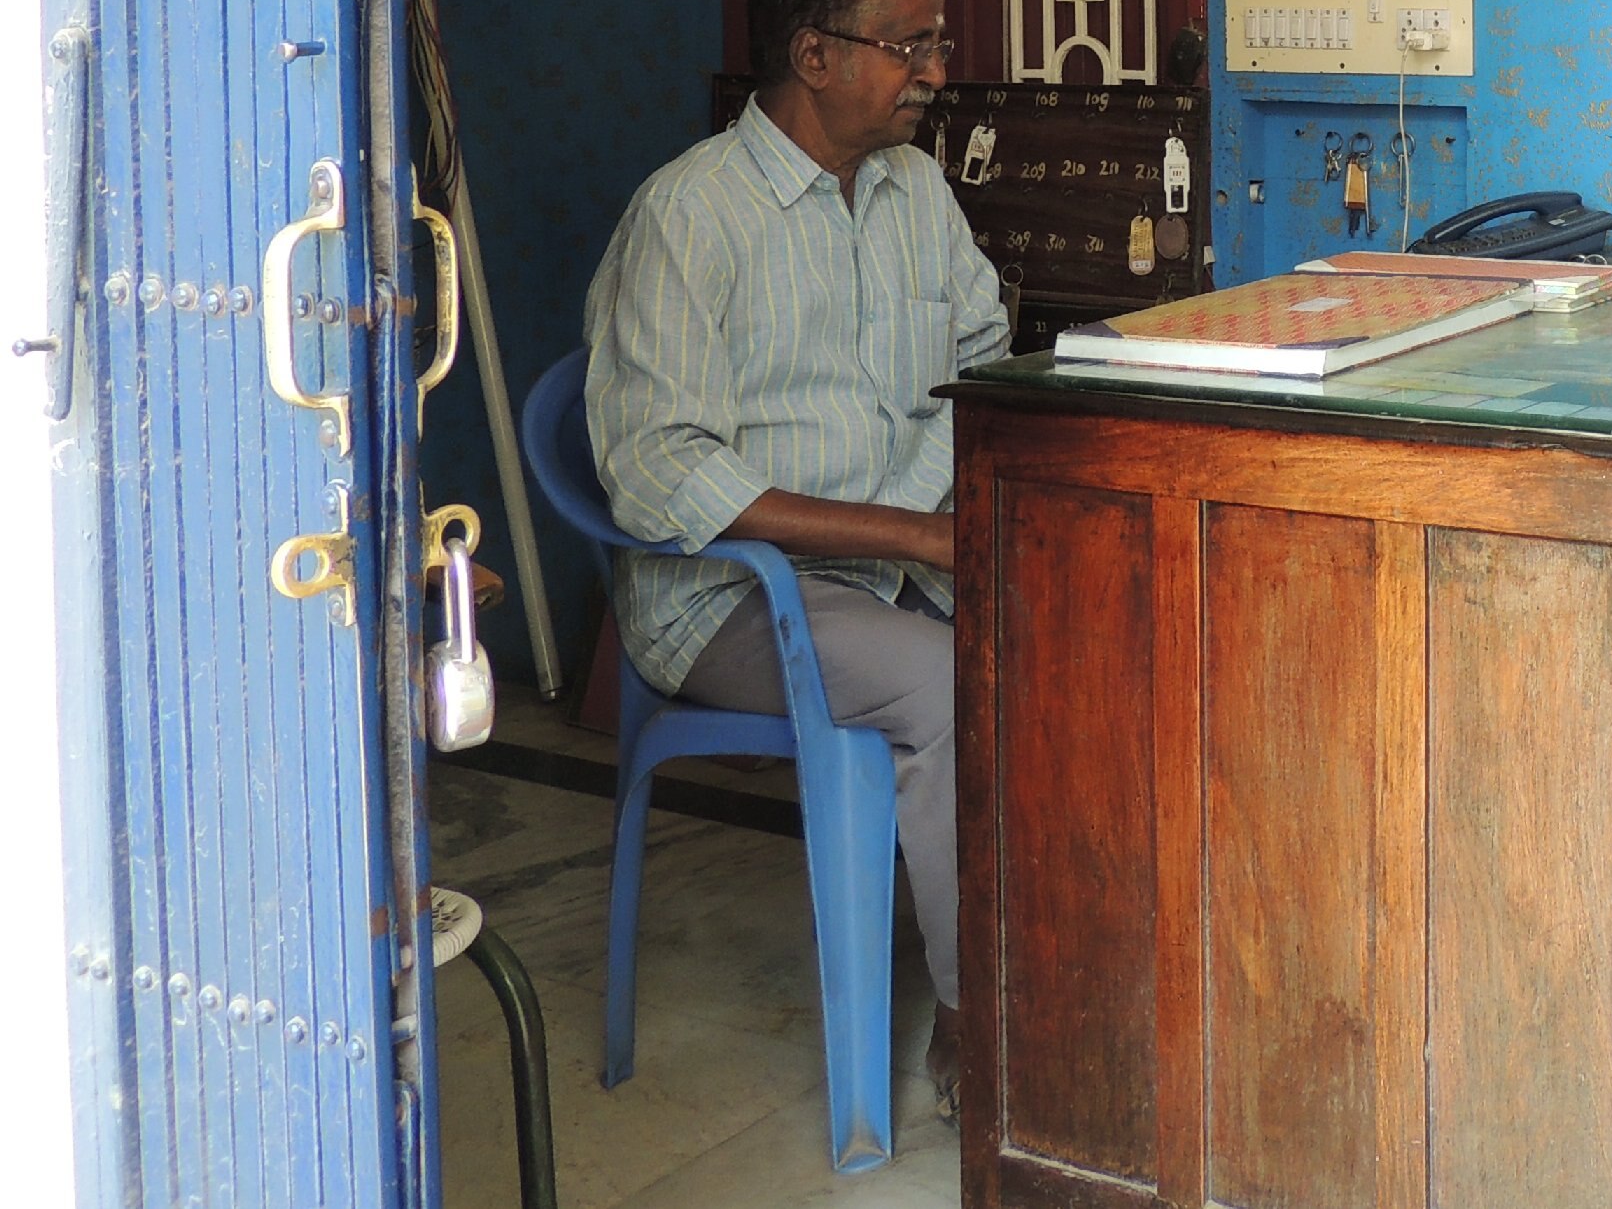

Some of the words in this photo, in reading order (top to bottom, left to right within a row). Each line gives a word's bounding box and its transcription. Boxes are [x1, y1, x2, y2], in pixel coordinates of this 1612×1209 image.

[987, 90, 1008, 107] 107
[1035, 91, 1059, 107] 108
[1085, 92, 1110, 112] 109
[1137, 94, 1155, 110] 110
[1020, 162, 1046, 182] 209
[1061, 159, 1085, 177] 210
[1099, 160, 1120, 176] 211
[1135, 163, 1160, 180] 212
[1006, 230, 1031, 252] 309
[1046, 233, 1066, 251] 310
[1085, 234, 1104, 253] 311
